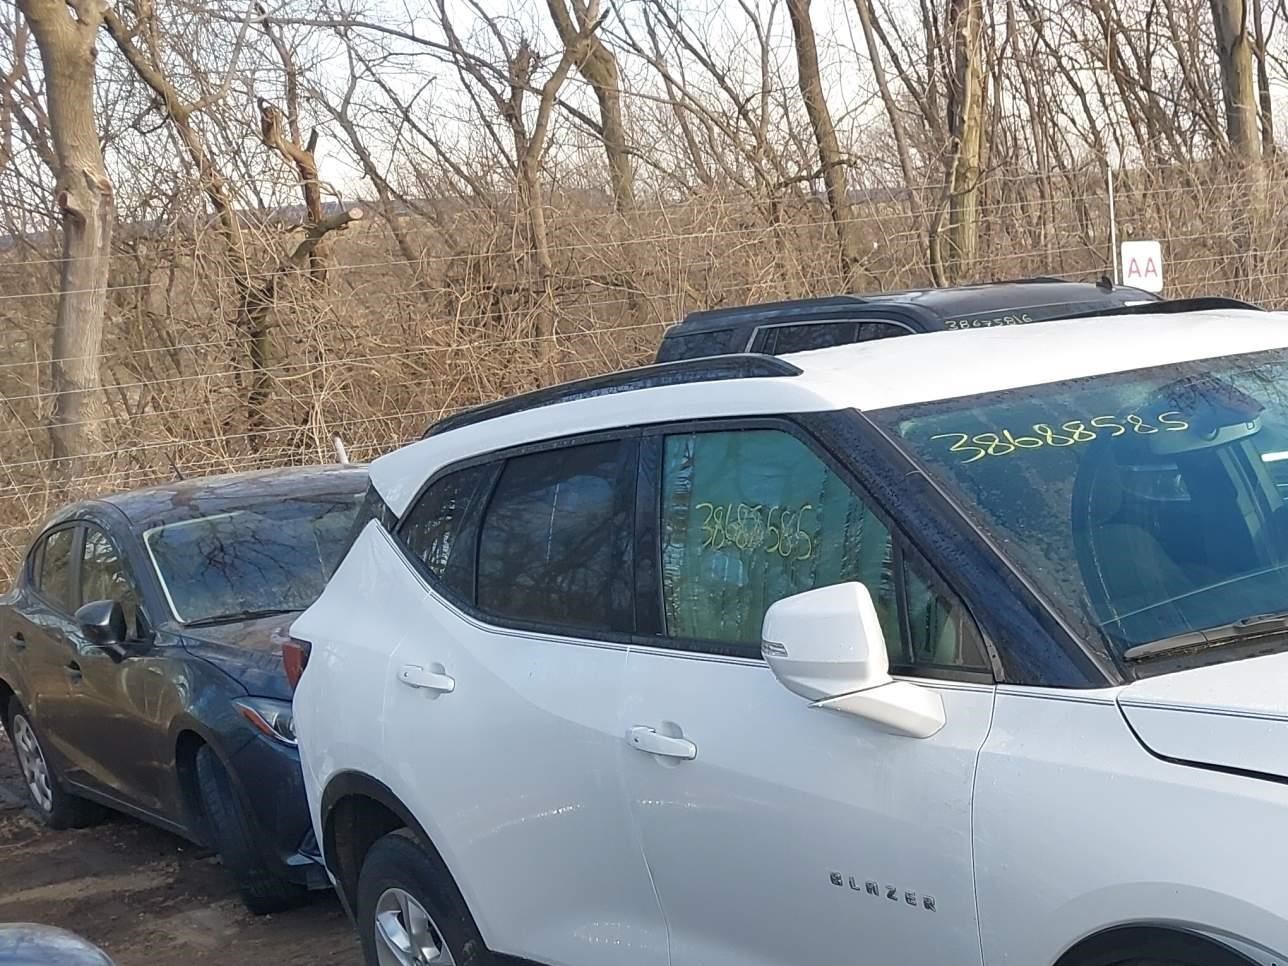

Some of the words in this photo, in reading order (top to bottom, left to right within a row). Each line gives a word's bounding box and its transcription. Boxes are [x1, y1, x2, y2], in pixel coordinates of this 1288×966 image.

[1127, 256, 1158, 278] AA
[931, 411, 1189, 464] 38688585
[829, 871, 937, 912] BLAZER
